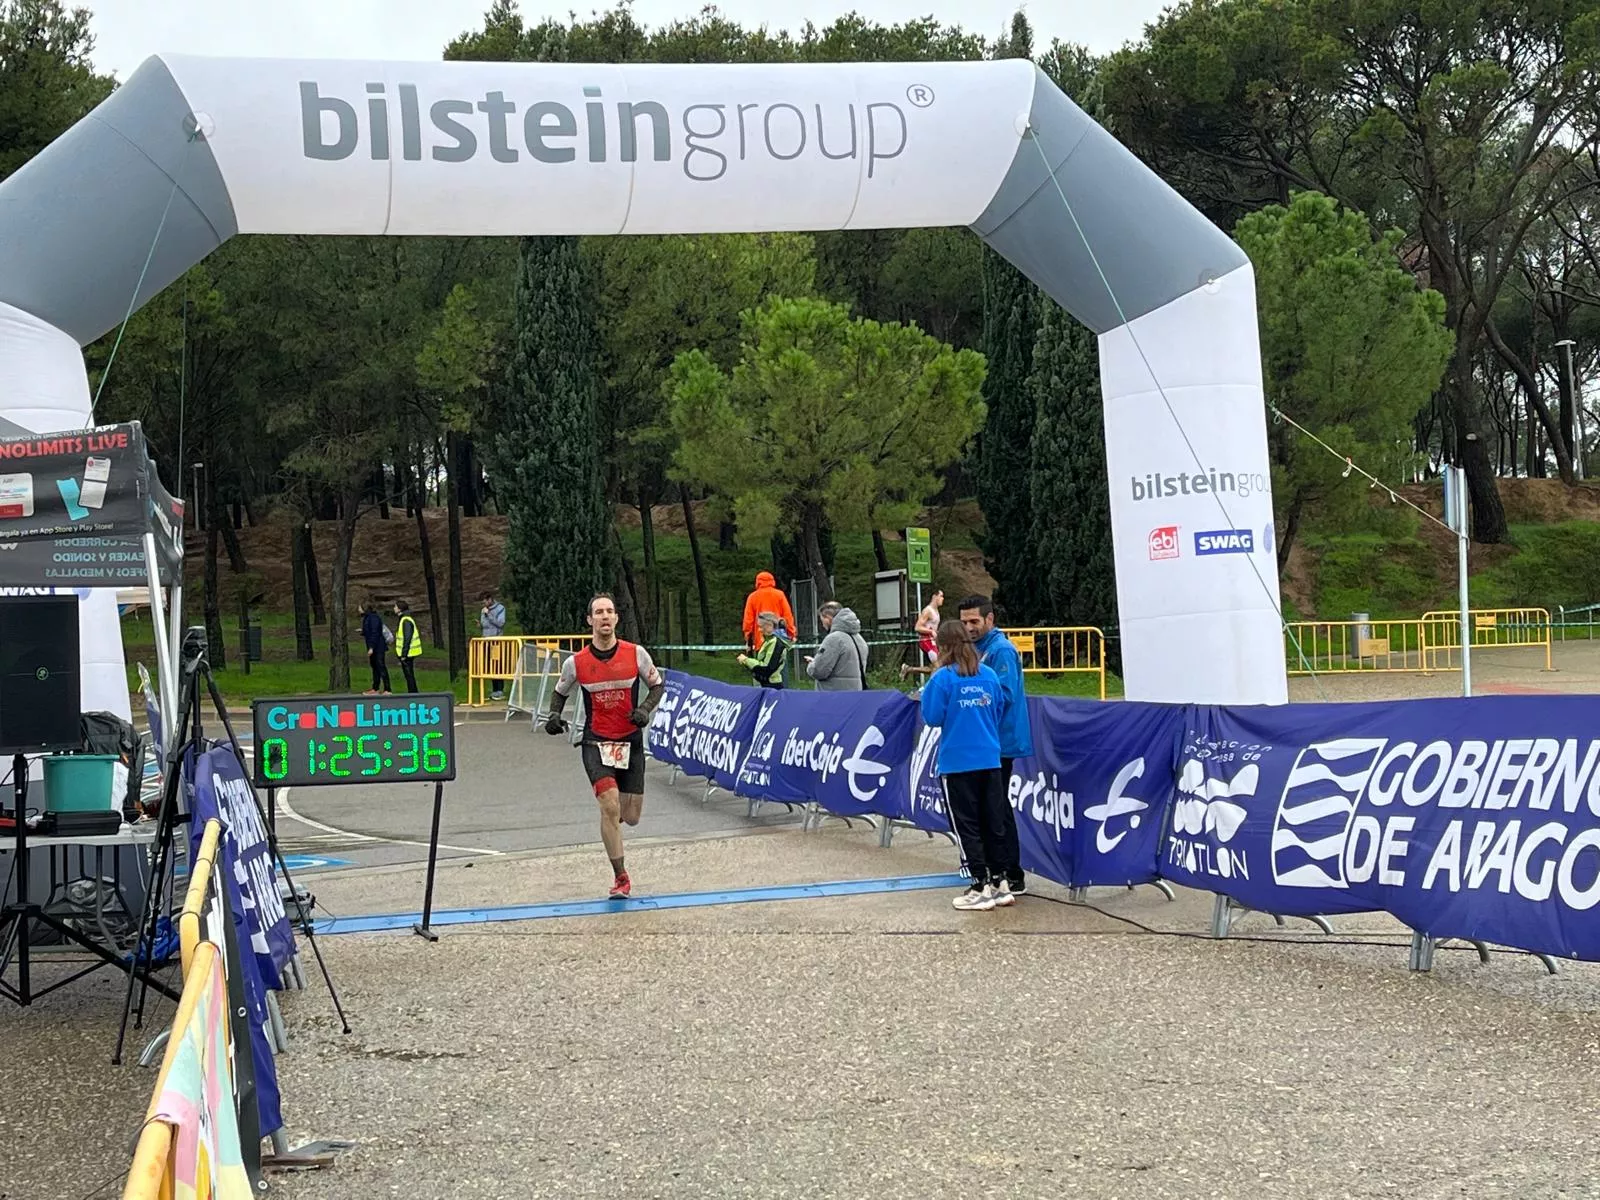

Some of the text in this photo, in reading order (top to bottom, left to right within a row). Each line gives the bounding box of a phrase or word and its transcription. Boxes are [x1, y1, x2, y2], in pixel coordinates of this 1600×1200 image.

[95, 424, 118, 433] APP
[0, 432, 128, 458] NOLIMITS LIVE
[79, 523, 93, 531] Play
[1199, 534, 1251, 550] SWAG
[595, 689, 625, 703] SERGIO
[691, 694, 742, 733] GOBIERNO
[681, 725, 741, 774] DE ARAGON
[1369, 738, 1600, 818] GOBIERN
[1345, 815, 1416, 887] DE
